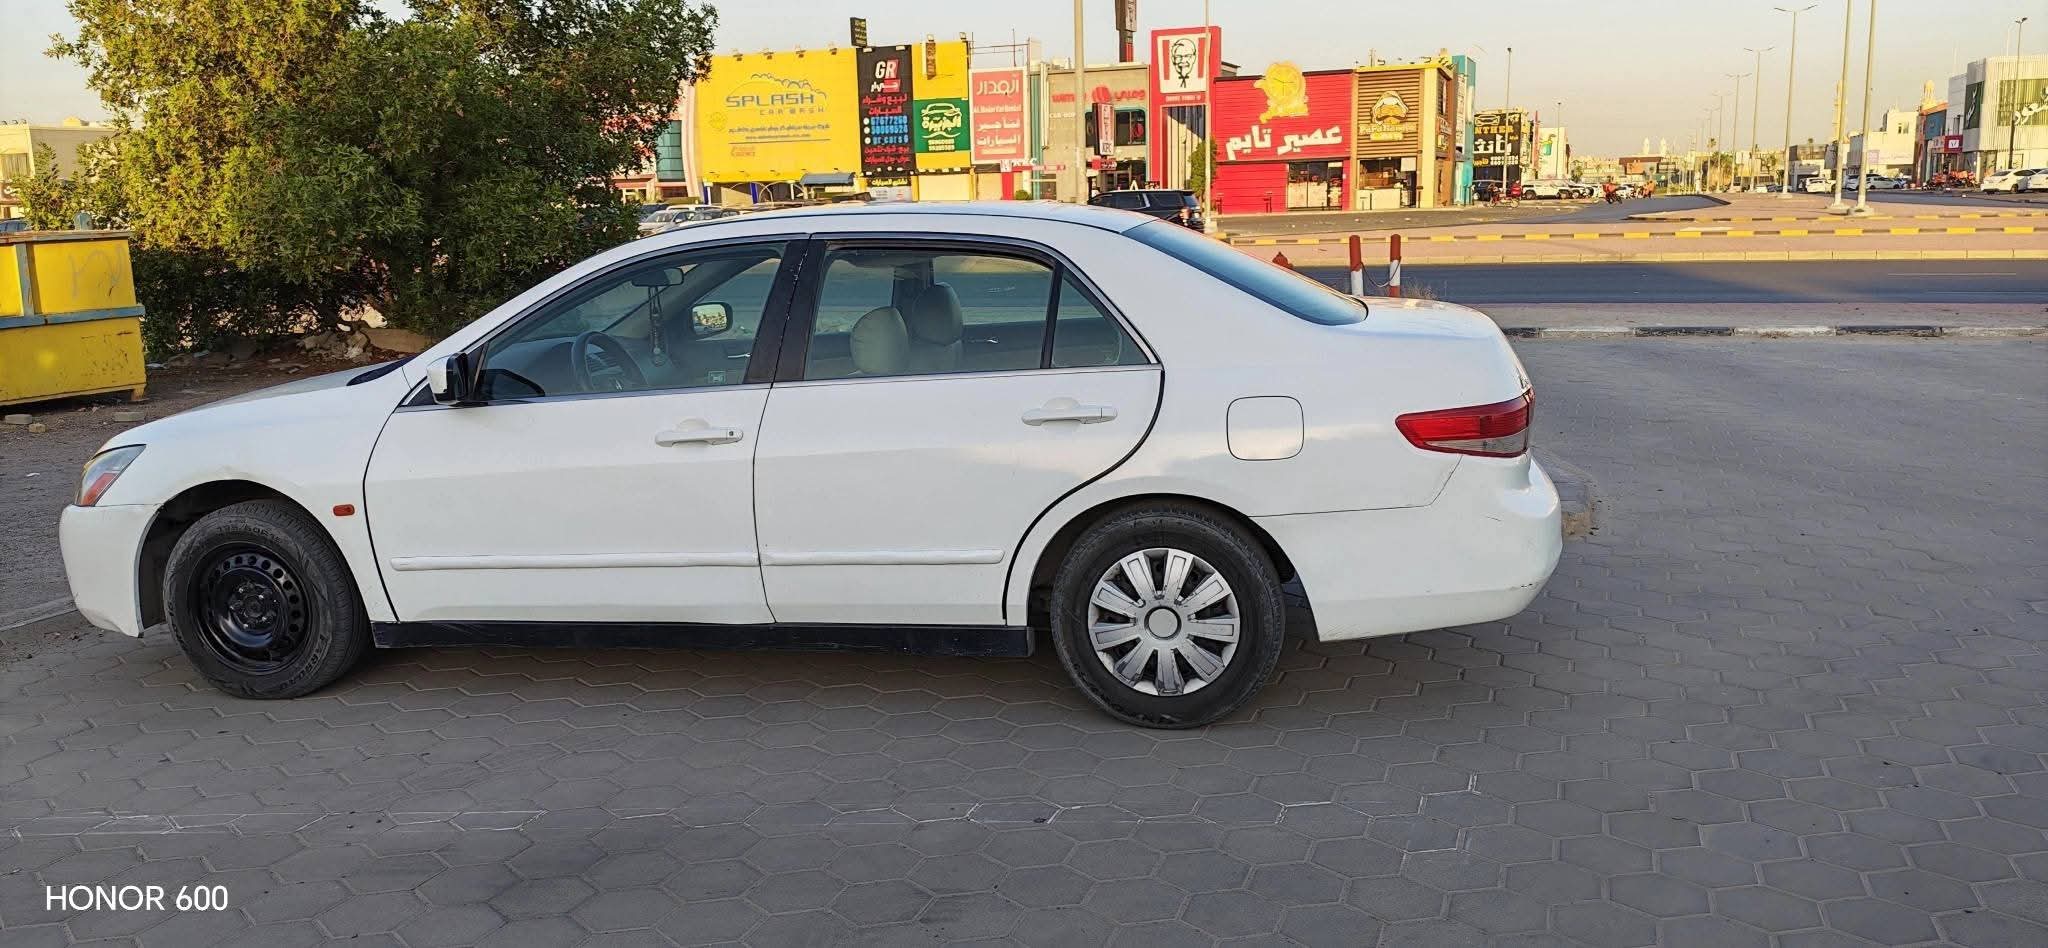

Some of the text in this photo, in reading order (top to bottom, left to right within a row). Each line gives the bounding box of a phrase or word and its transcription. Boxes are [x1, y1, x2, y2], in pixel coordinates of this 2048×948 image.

[874, 59, 898, 79] GR
[725, 93, 814, 107] SPLASH
[1474, 125, 1514, 134] NTHER
[1226, 125, 1343, 160] عصير تايم
